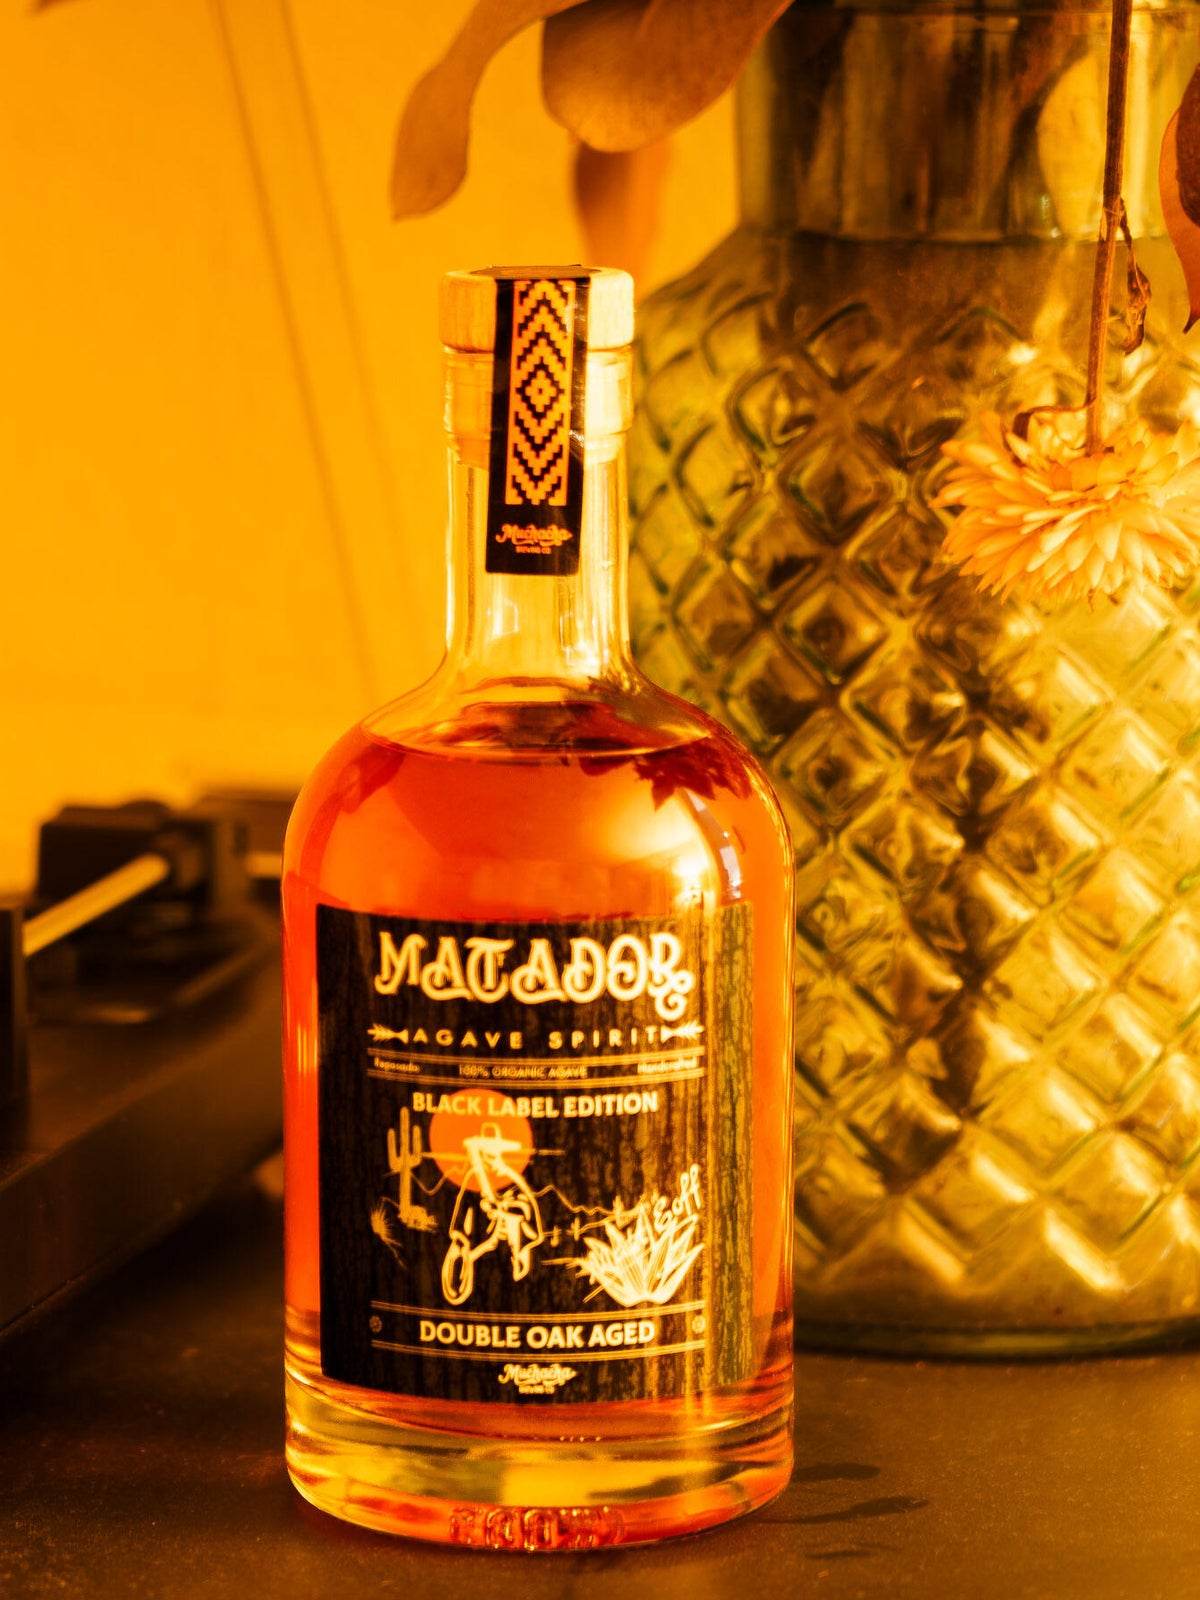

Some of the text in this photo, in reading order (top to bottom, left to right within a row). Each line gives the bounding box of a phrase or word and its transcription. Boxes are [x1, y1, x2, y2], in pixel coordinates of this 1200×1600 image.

[374, 931, 696, 1020] MATADOR
[413, 1028, 658, 1050] AGAVE SPIRIT
[459, 1064, 489, 1078] 100%
[492, 1066, 545, 1078] ORGANIC
[548, 1065, 588, 1078] AGAVE
[412, 1091, 658, 1119] BLACK LABEL EDITION
[420, 1320, 655, 1349] DOUBLE OAK AGED
